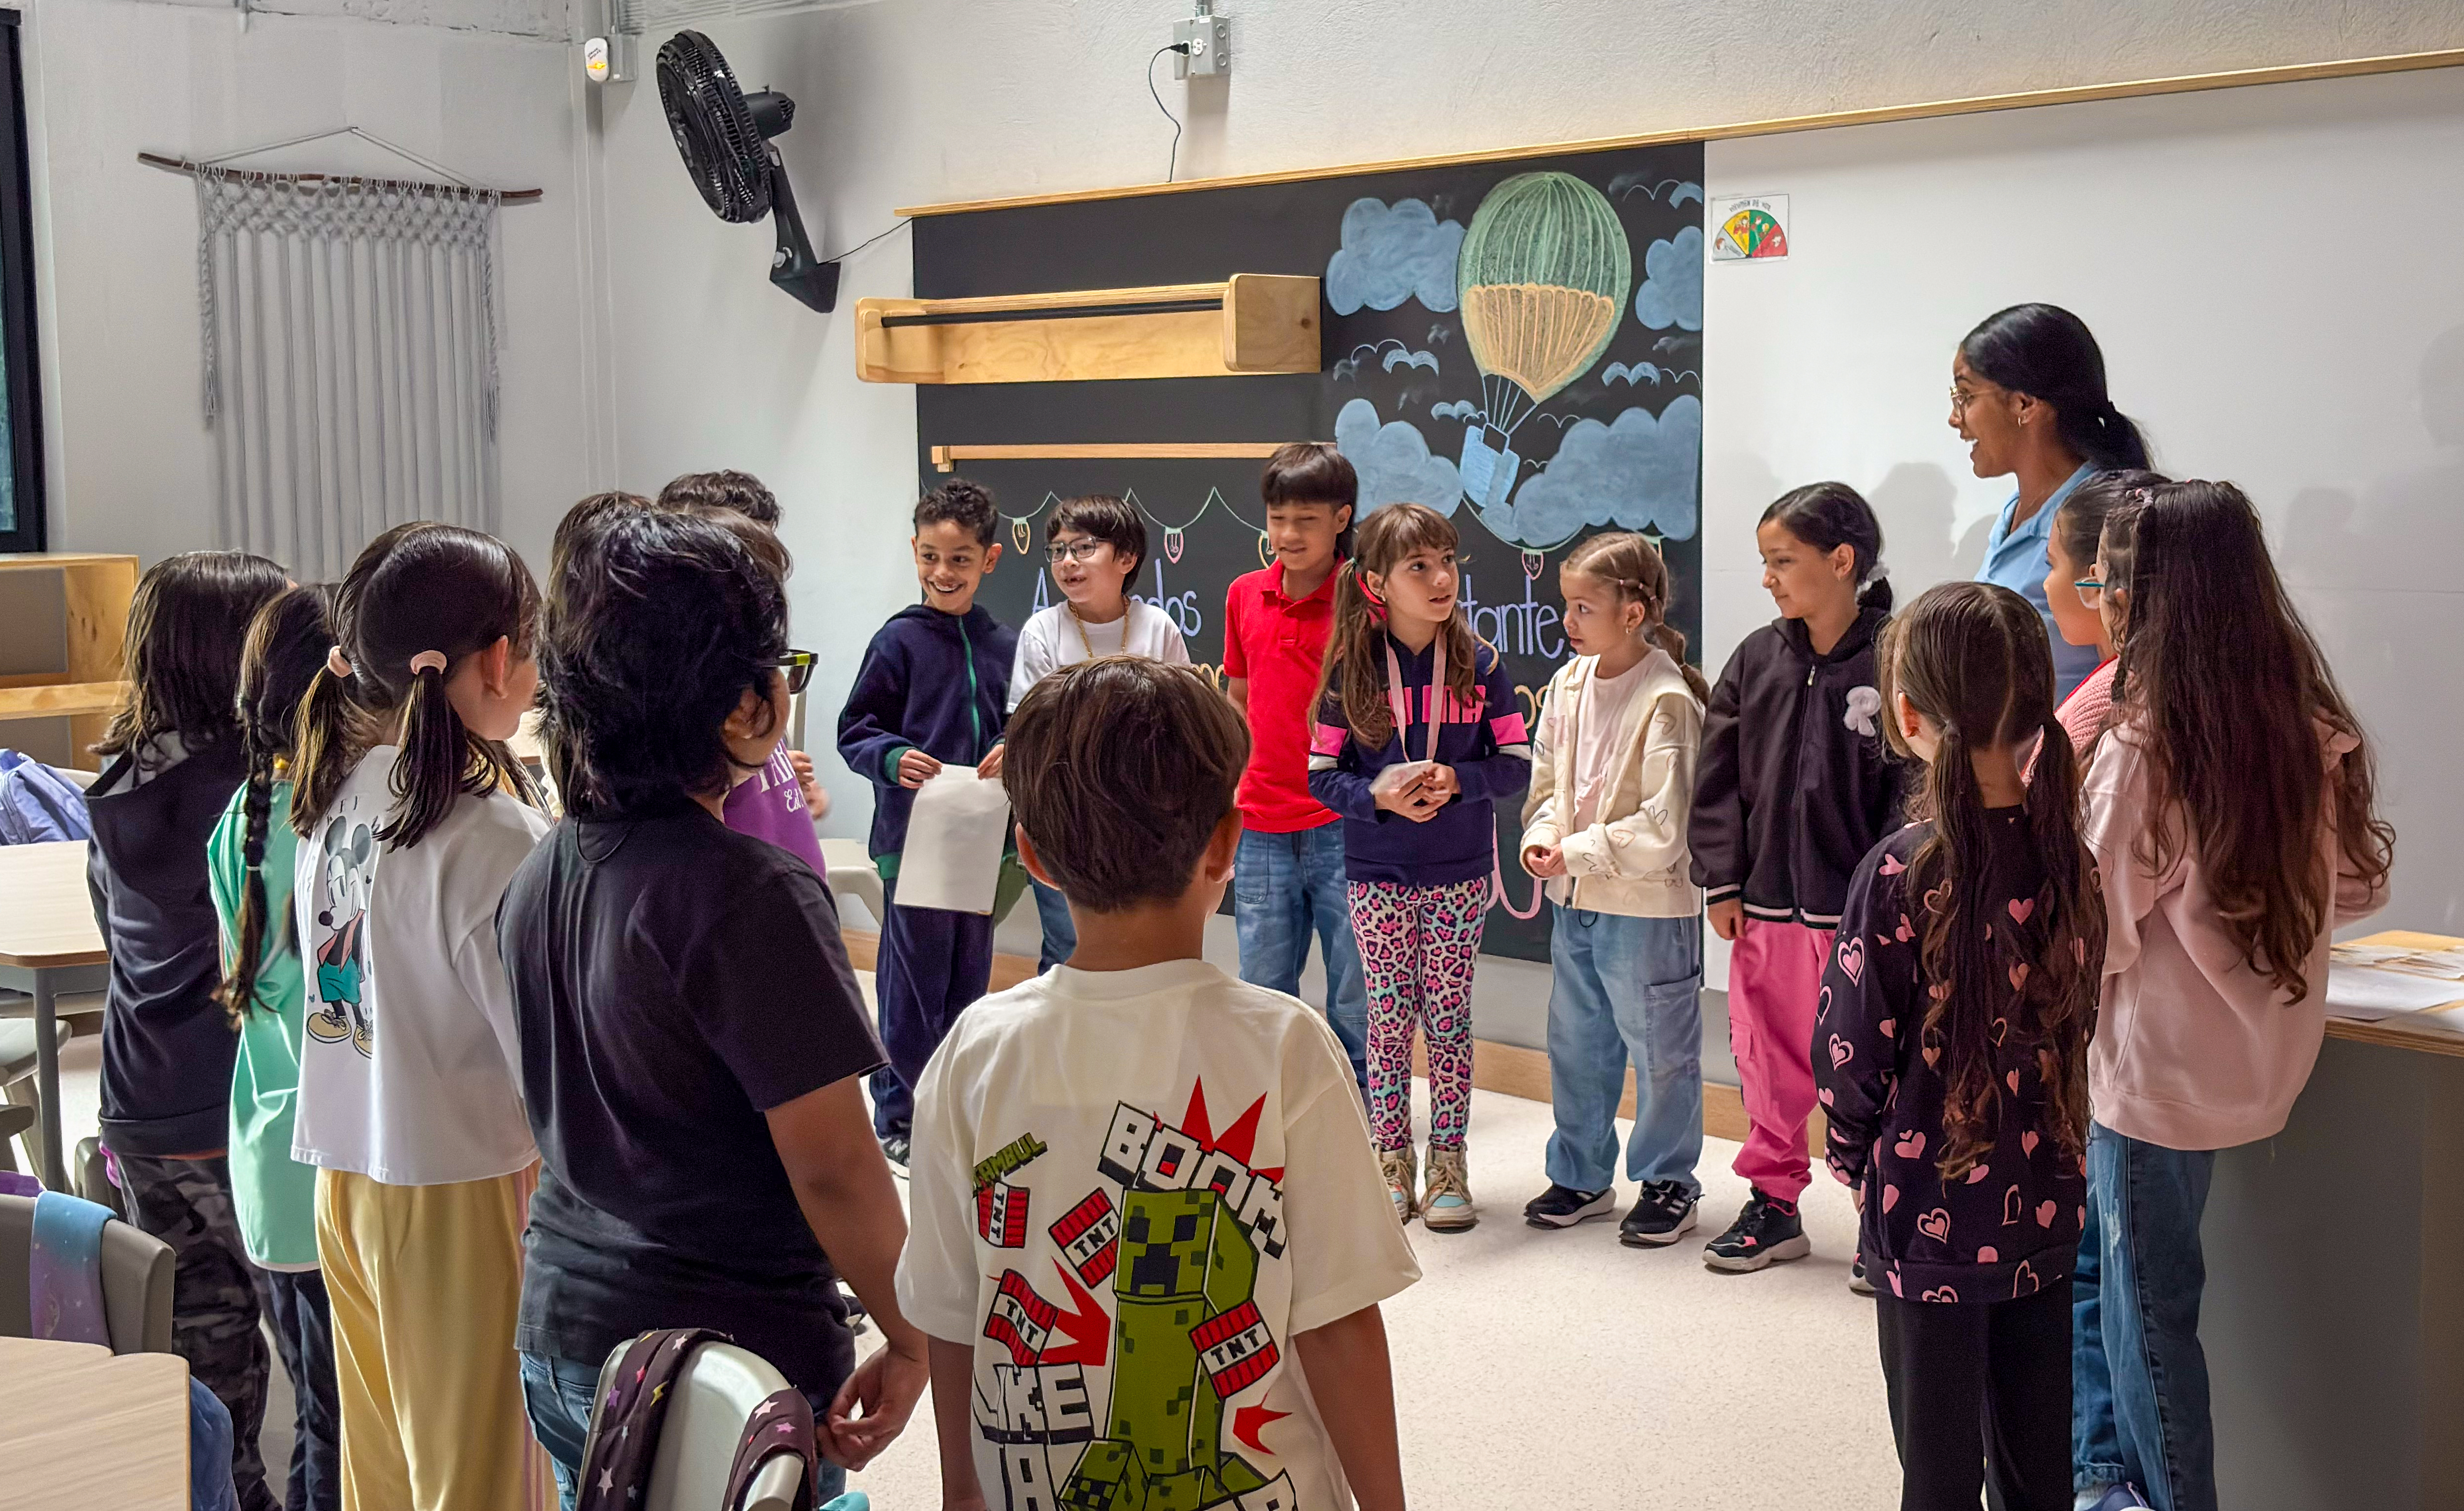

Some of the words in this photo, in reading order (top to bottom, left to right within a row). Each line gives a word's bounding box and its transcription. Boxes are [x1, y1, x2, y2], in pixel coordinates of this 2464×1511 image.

[1097, 1100, 1287, 1260] BOOM
[991, 1192, 1005, 1239] TNT
[1073, 1216, 1115, 1257] TNT
[1007, 1298, 1039, 1344] TNT
[1210, 1329, 1260, 1365] TNT
